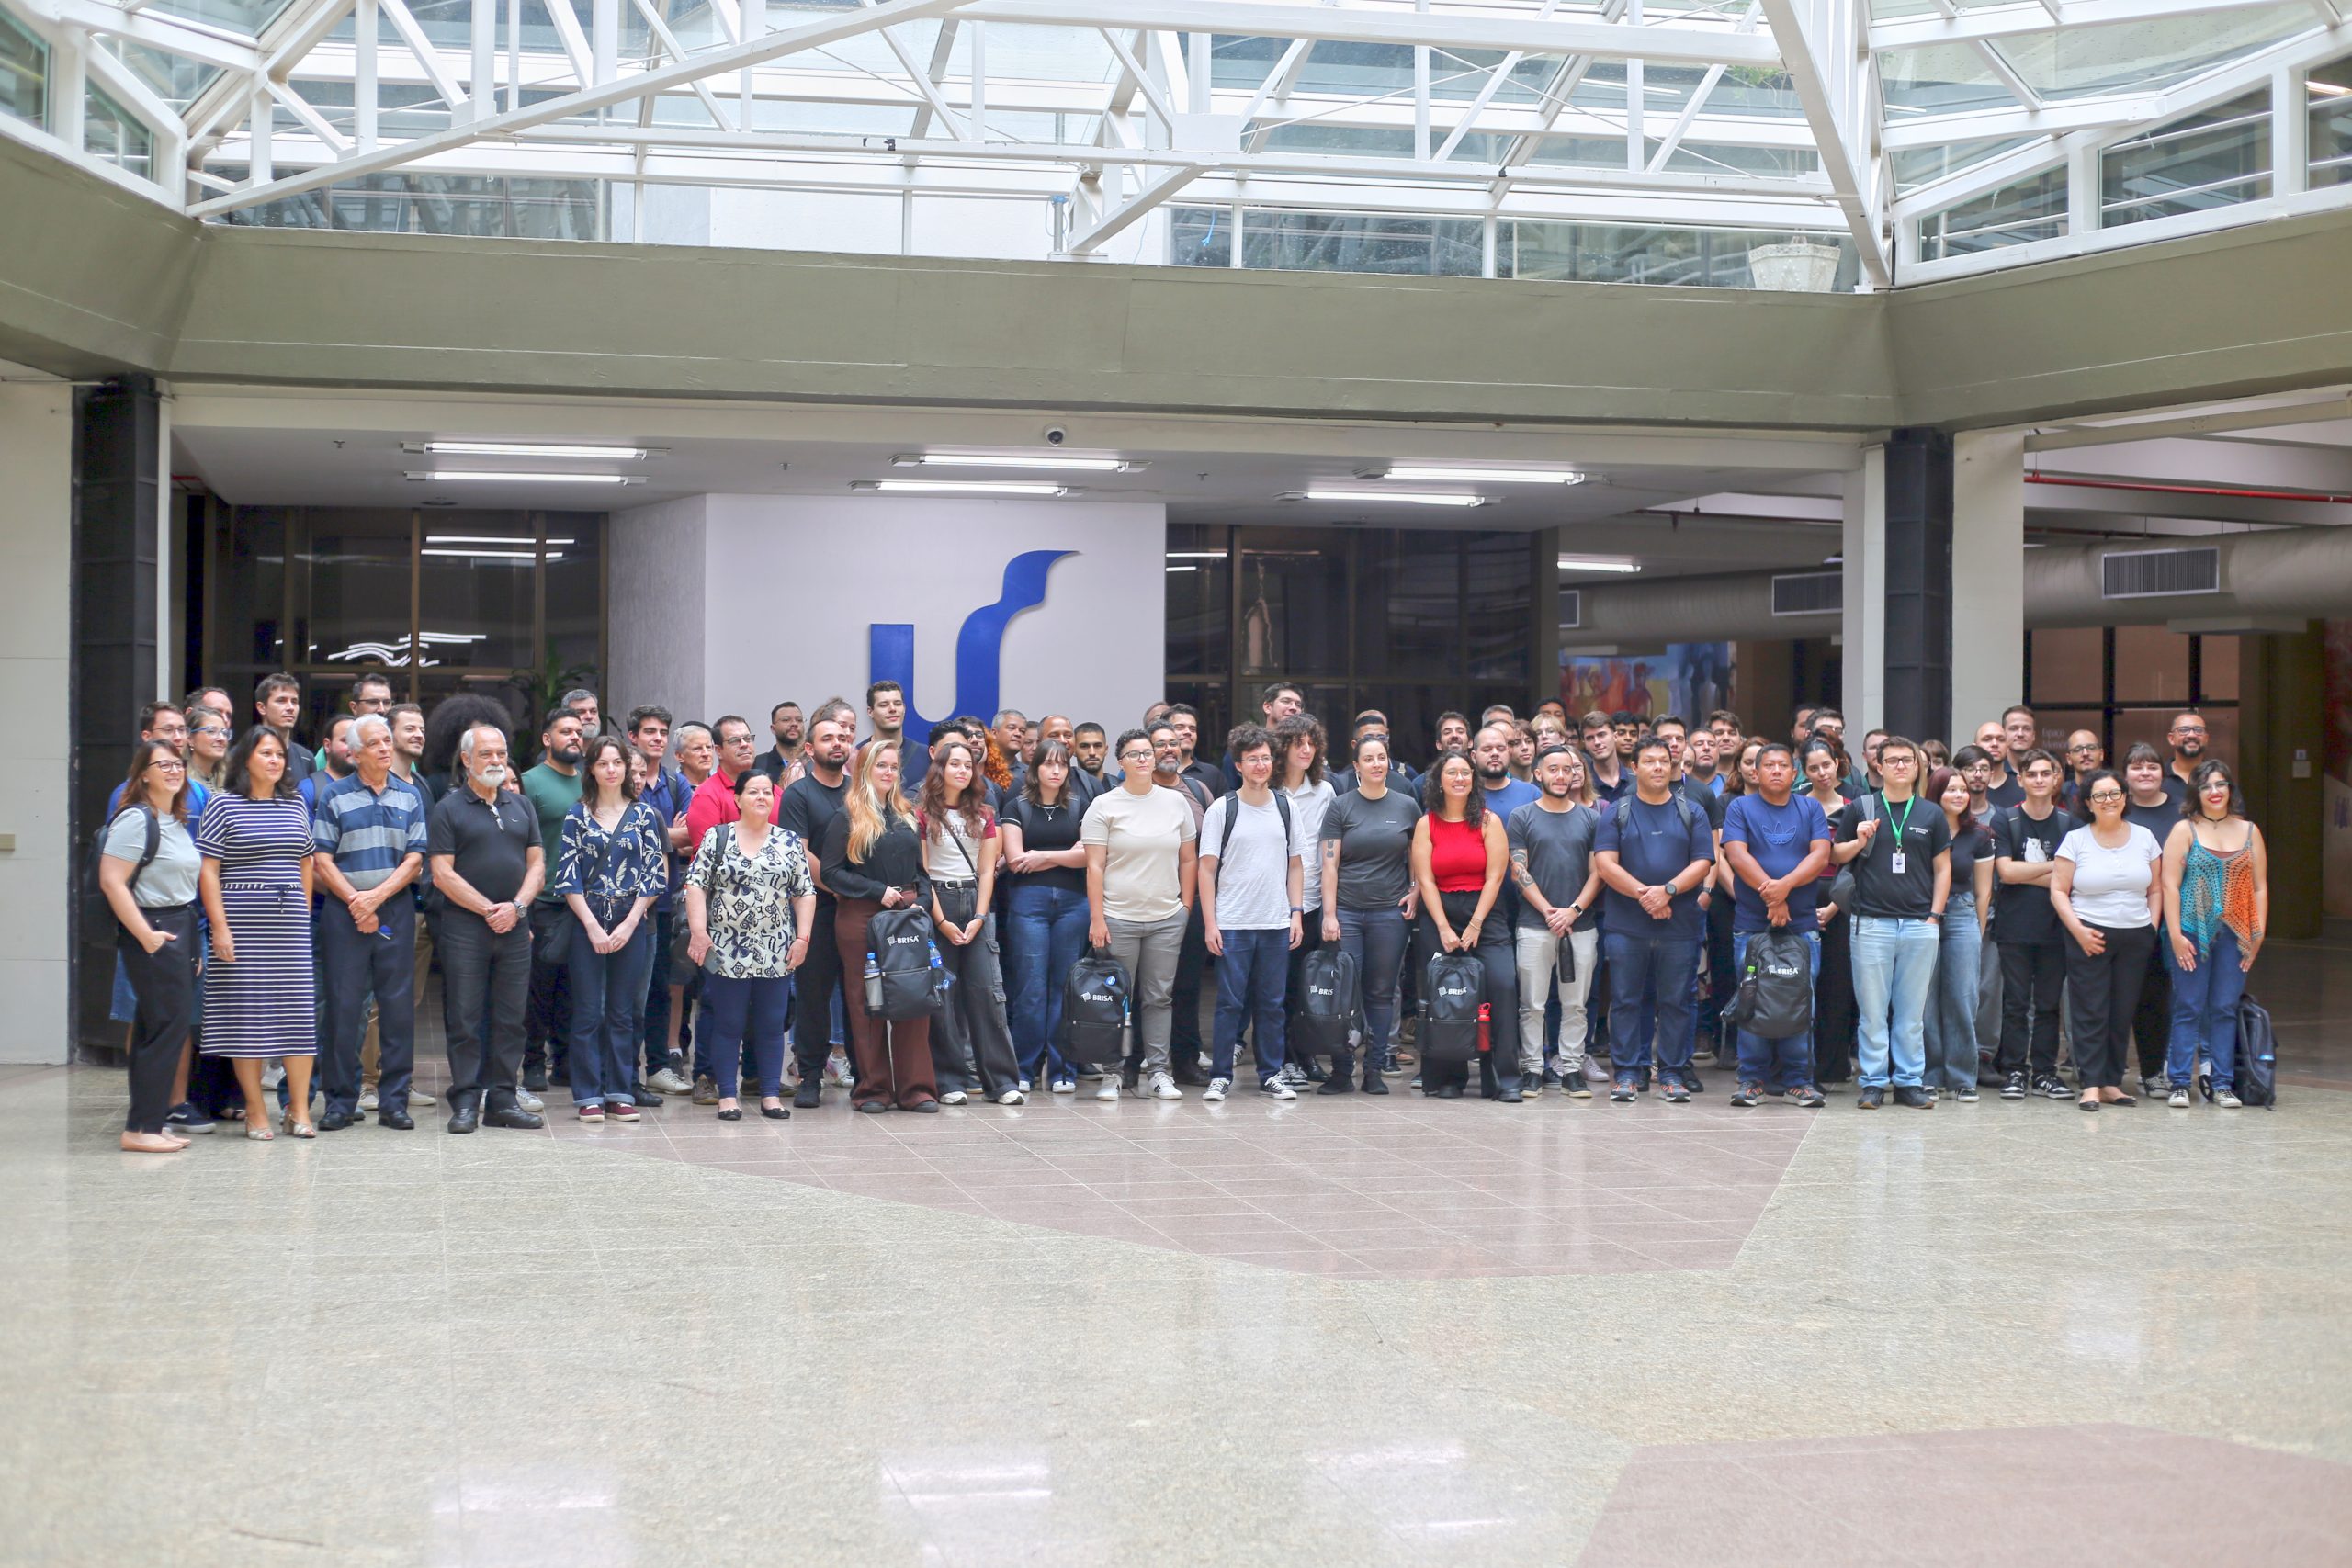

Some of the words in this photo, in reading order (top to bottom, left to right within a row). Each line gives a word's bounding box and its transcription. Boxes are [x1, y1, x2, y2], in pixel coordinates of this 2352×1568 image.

[897, 935, 919, 944] BRISA
[1318, 987, 1333, 996] BRIS
[1092, 994, 1114, 1002] BRISA
